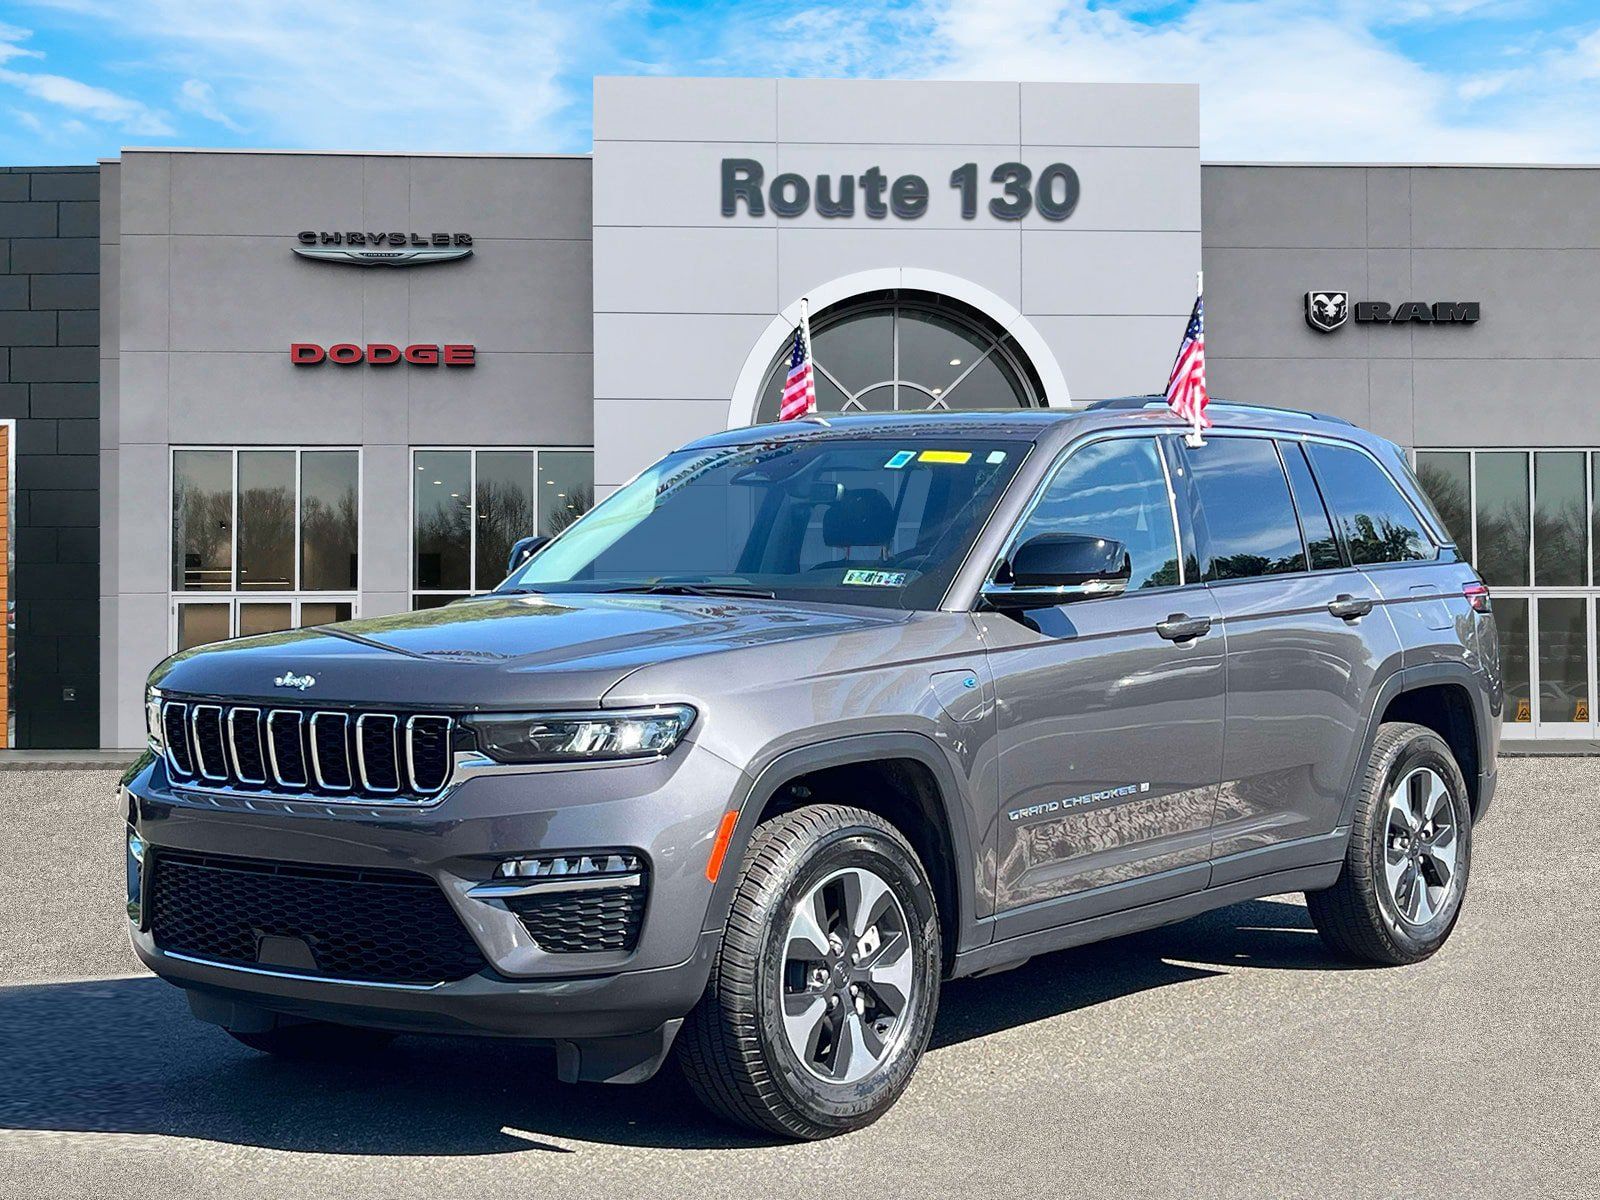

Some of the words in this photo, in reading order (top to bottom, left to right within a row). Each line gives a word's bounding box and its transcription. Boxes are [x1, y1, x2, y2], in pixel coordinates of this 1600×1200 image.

[721, 158, 930, 218] Route
[950, 162, 1081, 221] 130
[298, 231, 473, 245] CHRYSLER
[1355, 302, 1480, 323] RAM
[291, 343, 475, 366] DODGE
[1008, 801, 1059, 821] GRAND
[1062, 785, 1137, 809] CHEROKEE
